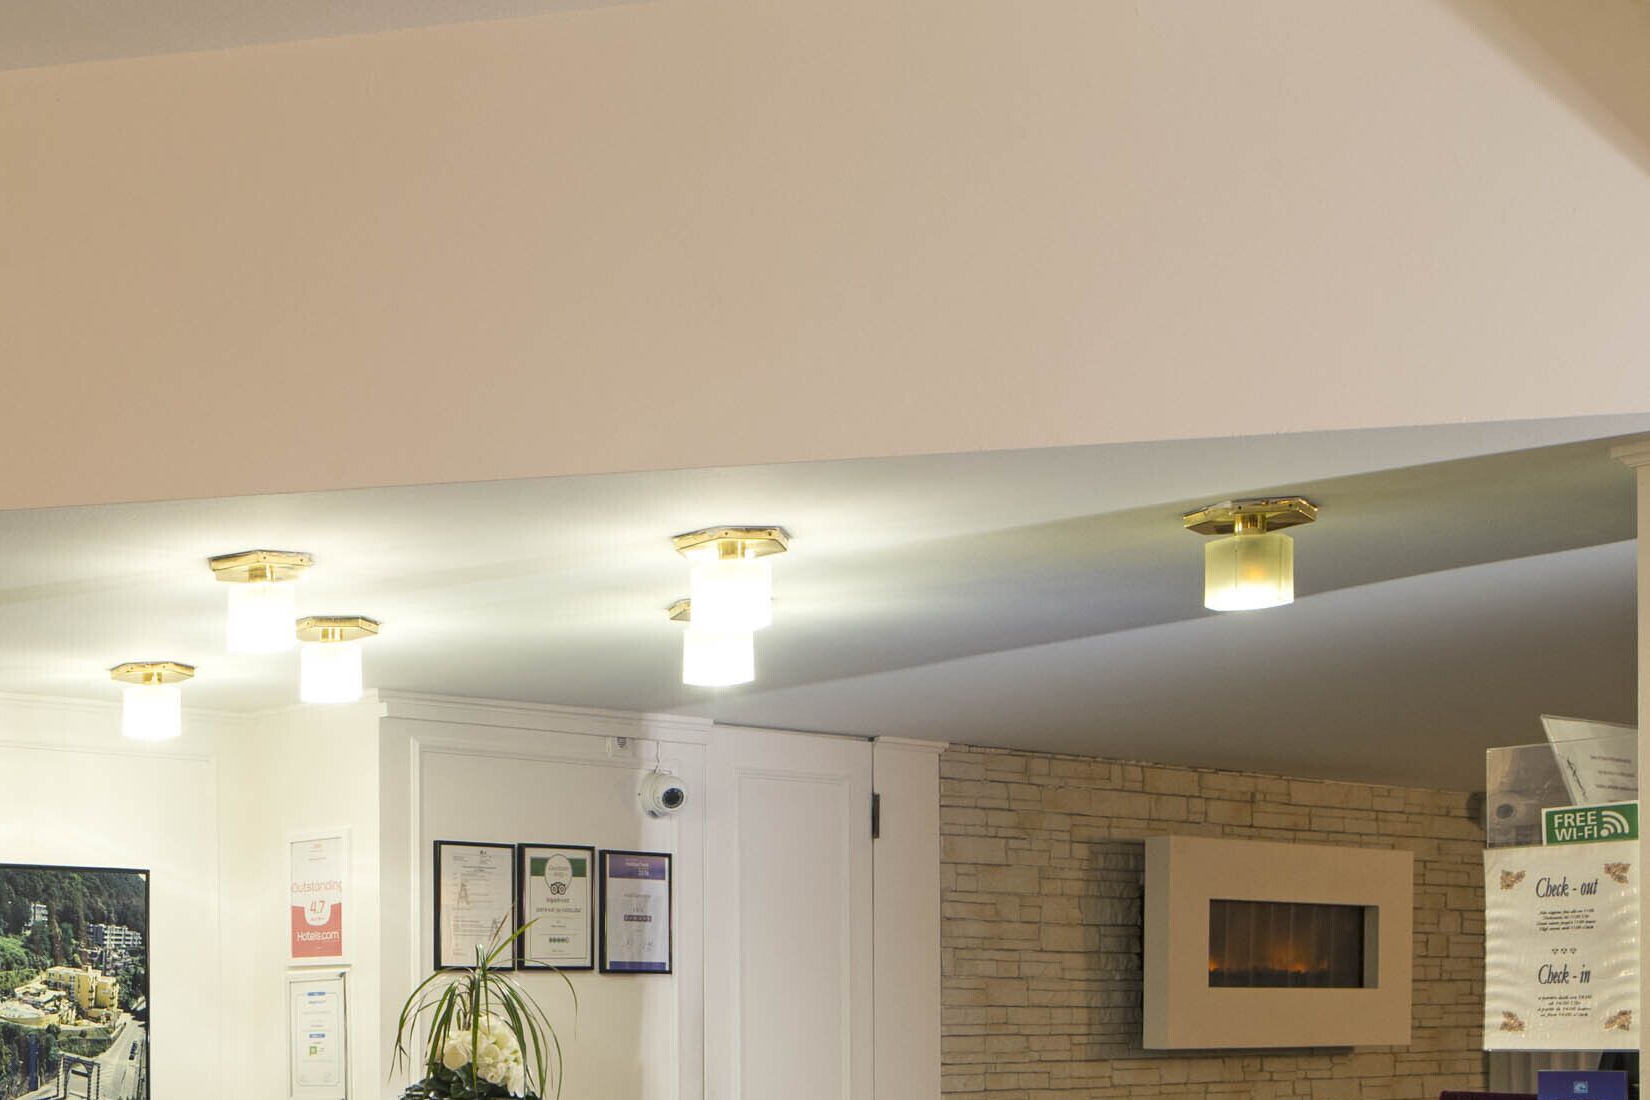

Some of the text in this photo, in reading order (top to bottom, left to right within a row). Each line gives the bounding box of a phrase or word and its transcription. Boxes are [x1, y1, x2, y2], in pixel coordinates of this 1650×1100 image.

[1553, 811, 1597, 828] FREE
[1554, 825, 1598, 841] WI-FI
[1535, 876, 1569, 898] Check
[1580, 878, 1599, 896] out
[1538, 963, 1569, 984] Check
[1580, 963, 1591, 984] in
